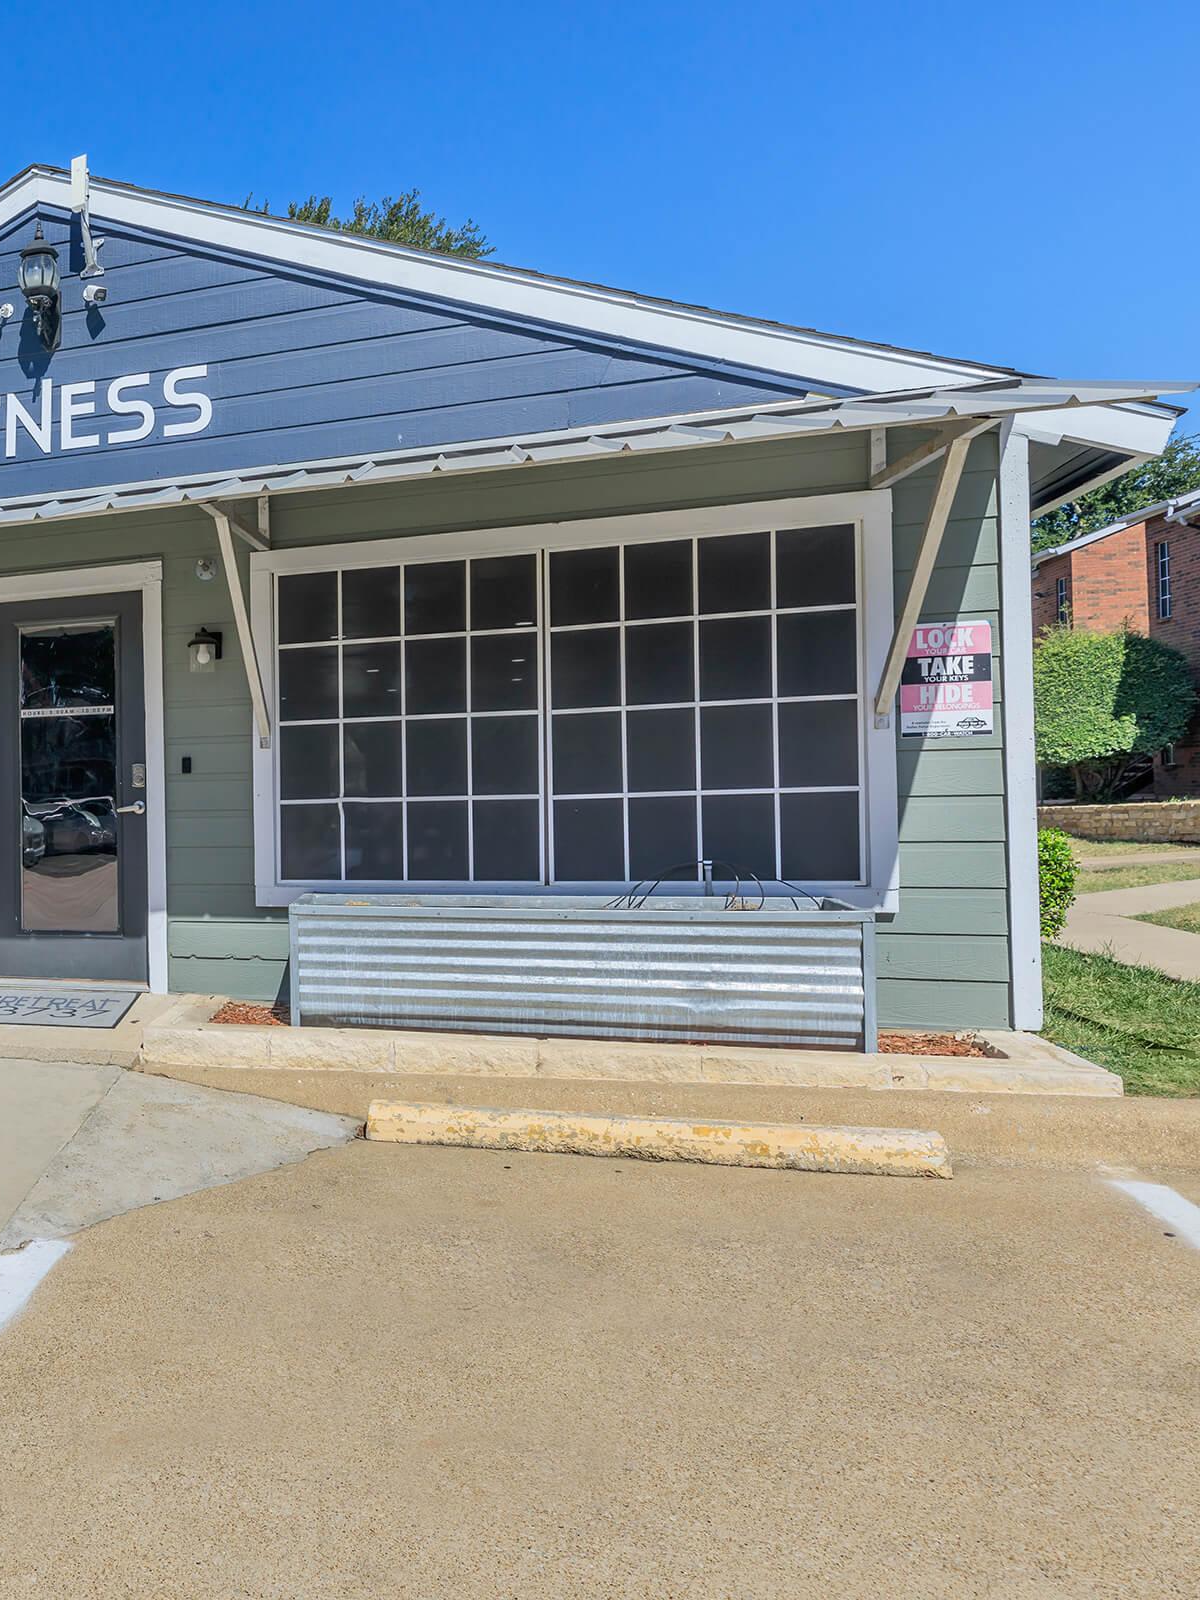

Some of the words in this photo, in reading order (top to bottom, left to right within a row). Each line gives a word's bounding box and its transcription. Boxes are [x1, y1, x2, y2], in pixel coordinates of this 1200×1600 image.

[915, 627, 975, 649] LOCK
[917, 655, 974, 677] TAKE
[924, 675, 948, 683] YOUR
[948, 674, 969, 682] KEYS
[919, 684, 973, 705] HIDE
